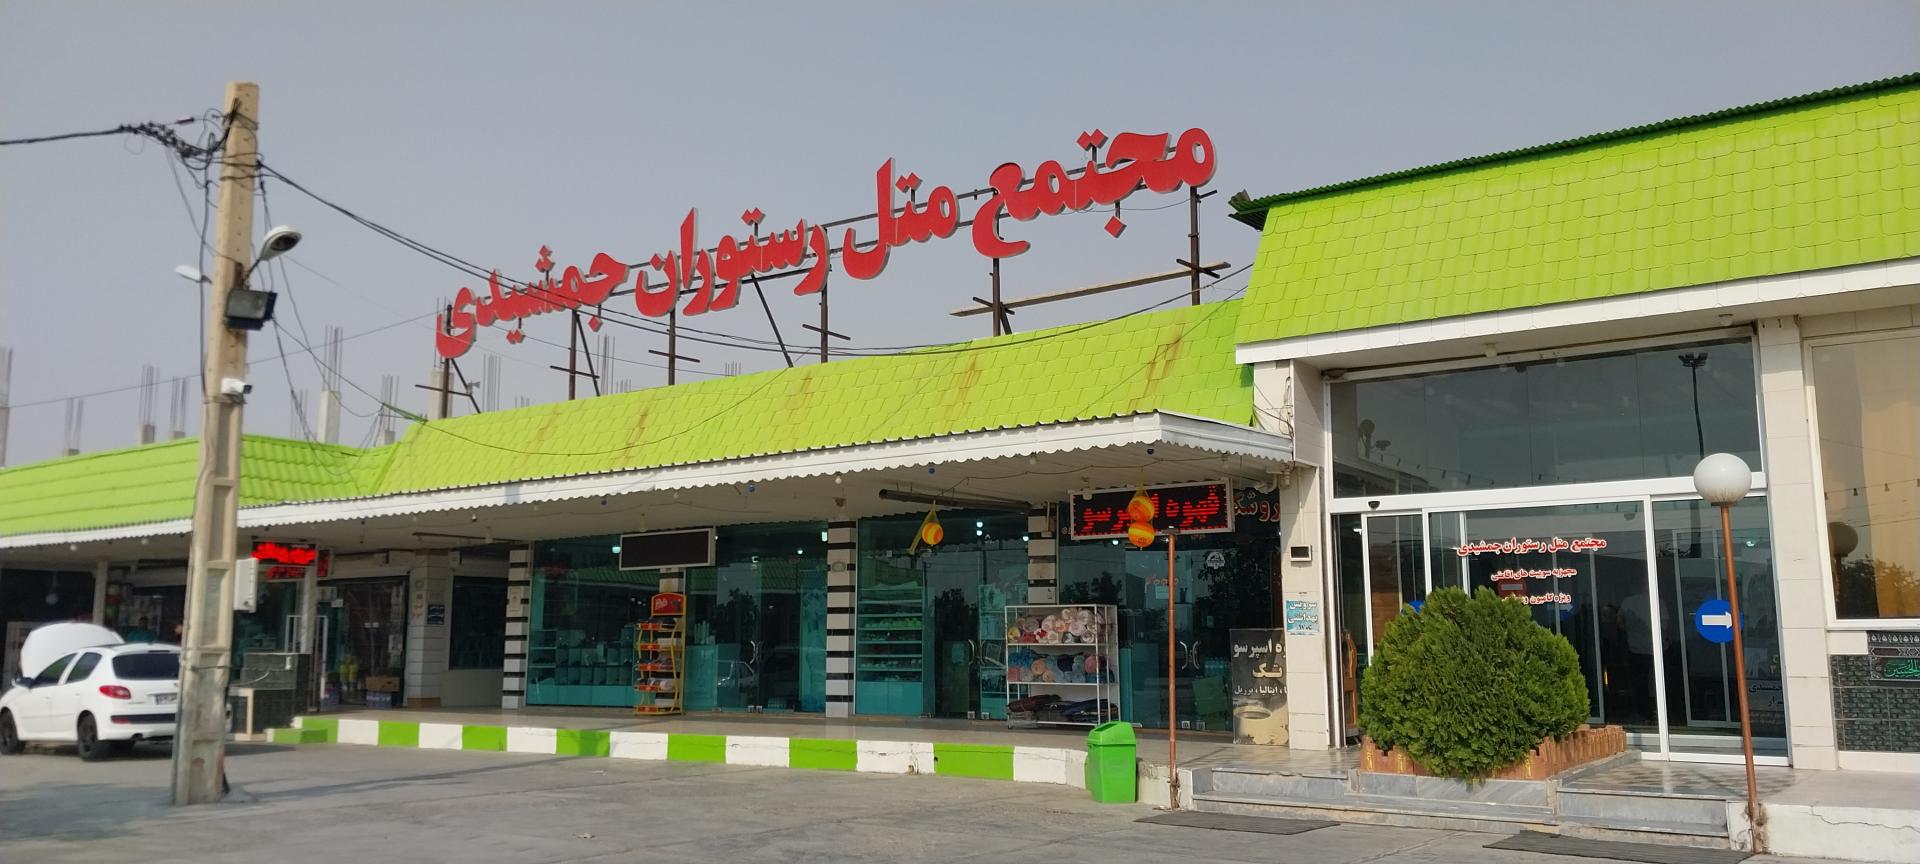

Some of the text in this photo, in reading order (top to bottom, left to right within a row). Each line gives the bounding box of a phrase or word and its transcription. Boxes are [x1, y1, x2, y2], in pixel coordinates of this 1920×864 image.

[435, 127, 1218, 359] مجتمع متل رستوران جمشیدی
[1165, 484, 1221, 528] قهوه
[1458, 537, 1606, 555] مجتمع متل رستوران جمشیدی
[1514, 568, 1529, 580] های
[1530, 592, 1554, 604] کامیون
[1554, 592, 1571, 603] ویژه
